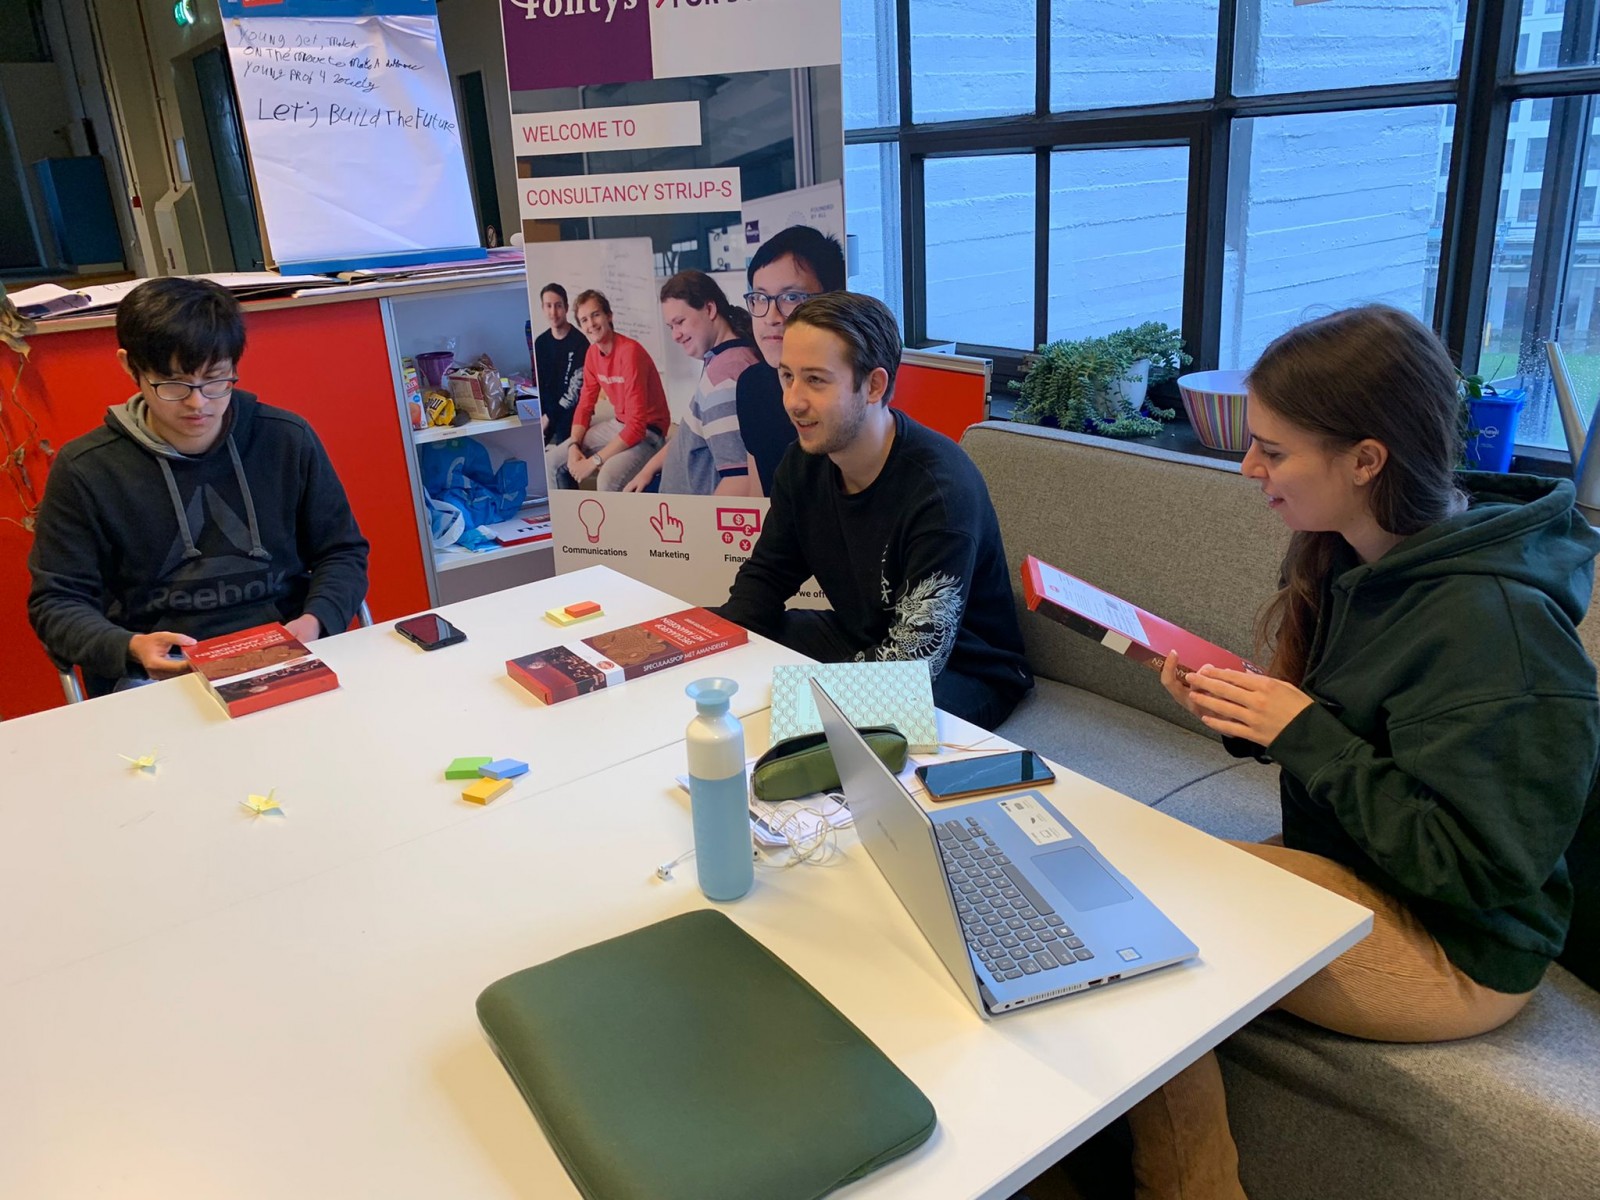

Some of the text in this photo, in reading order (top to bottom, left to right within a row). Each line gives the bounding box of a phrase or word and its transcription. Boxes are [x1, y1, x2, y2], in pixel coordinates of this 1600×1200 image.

[522, 118, 636, 143] WELCOME TO
[526, 180, 732, 207] CONSULTANCY STRIJP-S
[562, 545, 628, 557] Communications
[650, 549, 690, 561] Marketing
[724, 554, 752, 563] Finan
[145, 570, 287, 611] Reebok
[643, 641, 729, 672] SPECULAASPOP MET AMANDELEN
